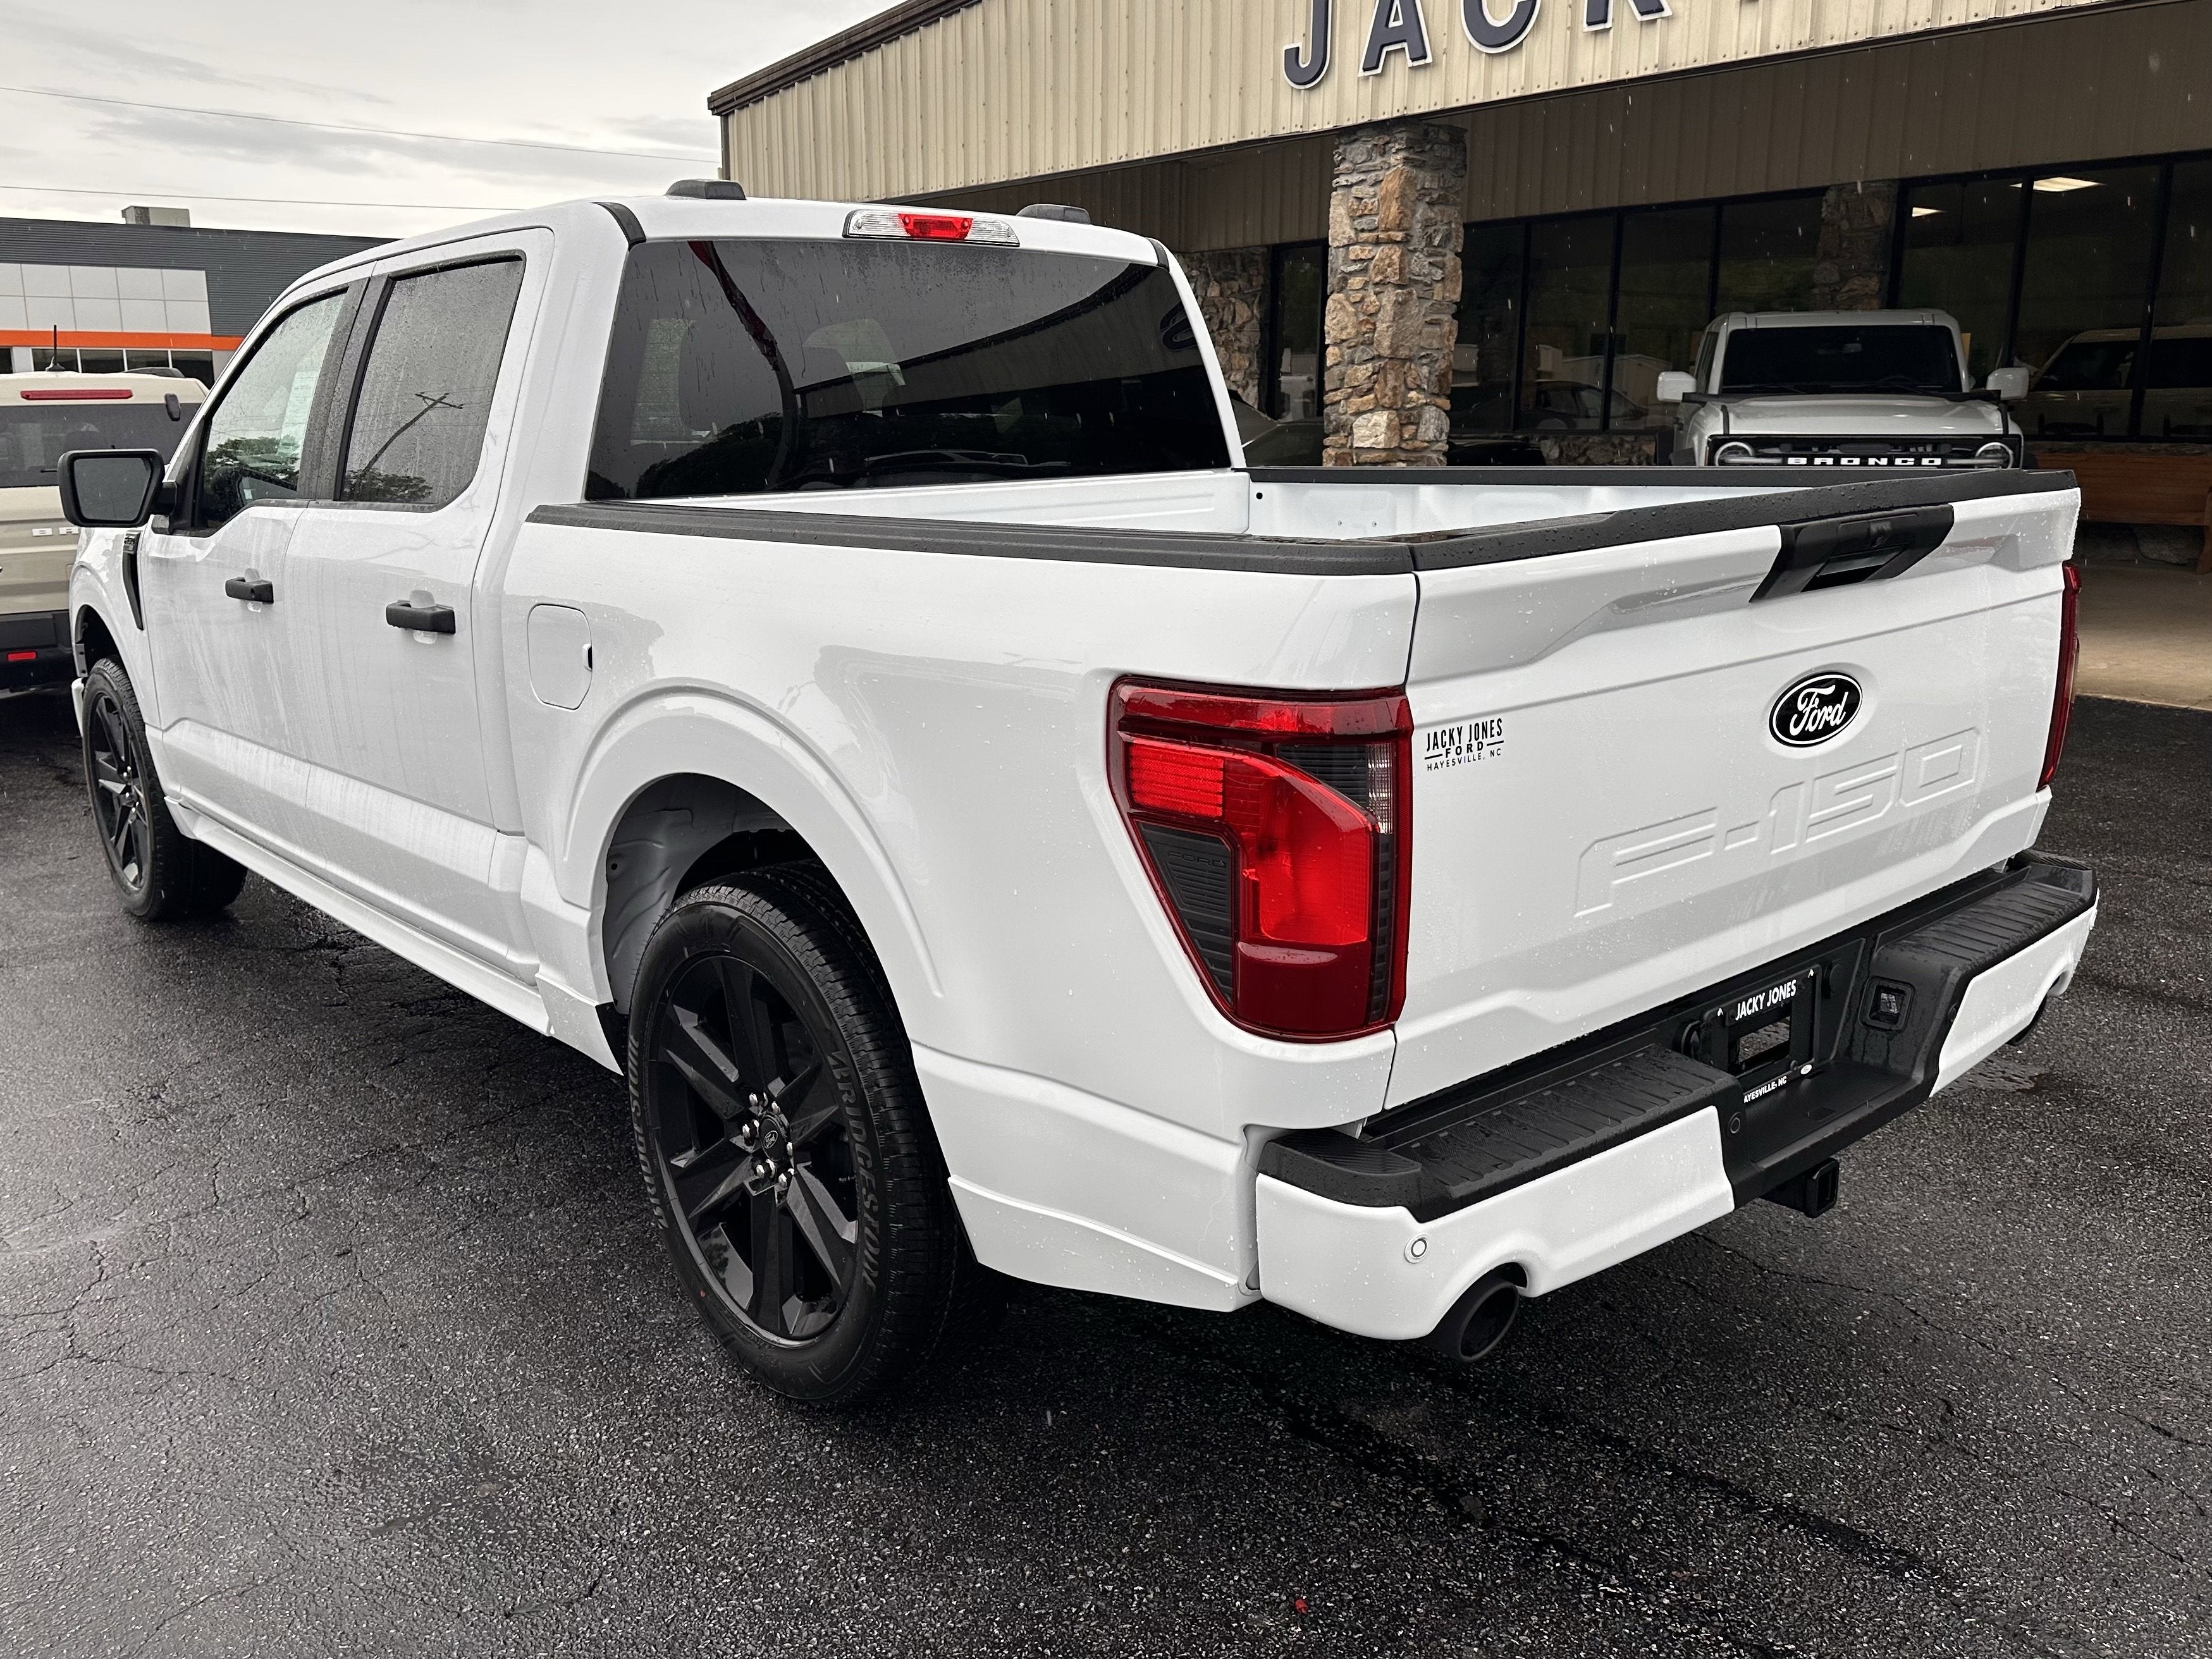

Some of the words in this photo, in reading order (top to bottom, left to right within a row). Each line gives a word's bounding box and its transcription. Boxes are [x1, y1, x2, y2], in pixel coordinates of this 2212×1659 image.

[1787, 457, 1942, 466] BRONCO
[1789, 683, 1848, 736] Ford
[1427, 726, 1463, 752] JACKY
[1468, 718, 1503, 743] JONES
[1427, 752, 1485, 772] HAYESVILLE,
[1490, 748, 1501, 758] NC
[1445, 741, 1484, 759] FORD
[1574, 726, 1982, 917] F-150
[1167, 850, 1227, 869] FORD
[1735, 992, 1766, 1021] JACKY
[1766, 979, 1797, 1007] JONES
[1743, 1080, 1778, 1104] AYESVILLE,
[1778, 1075, 1787, 1087] NC
